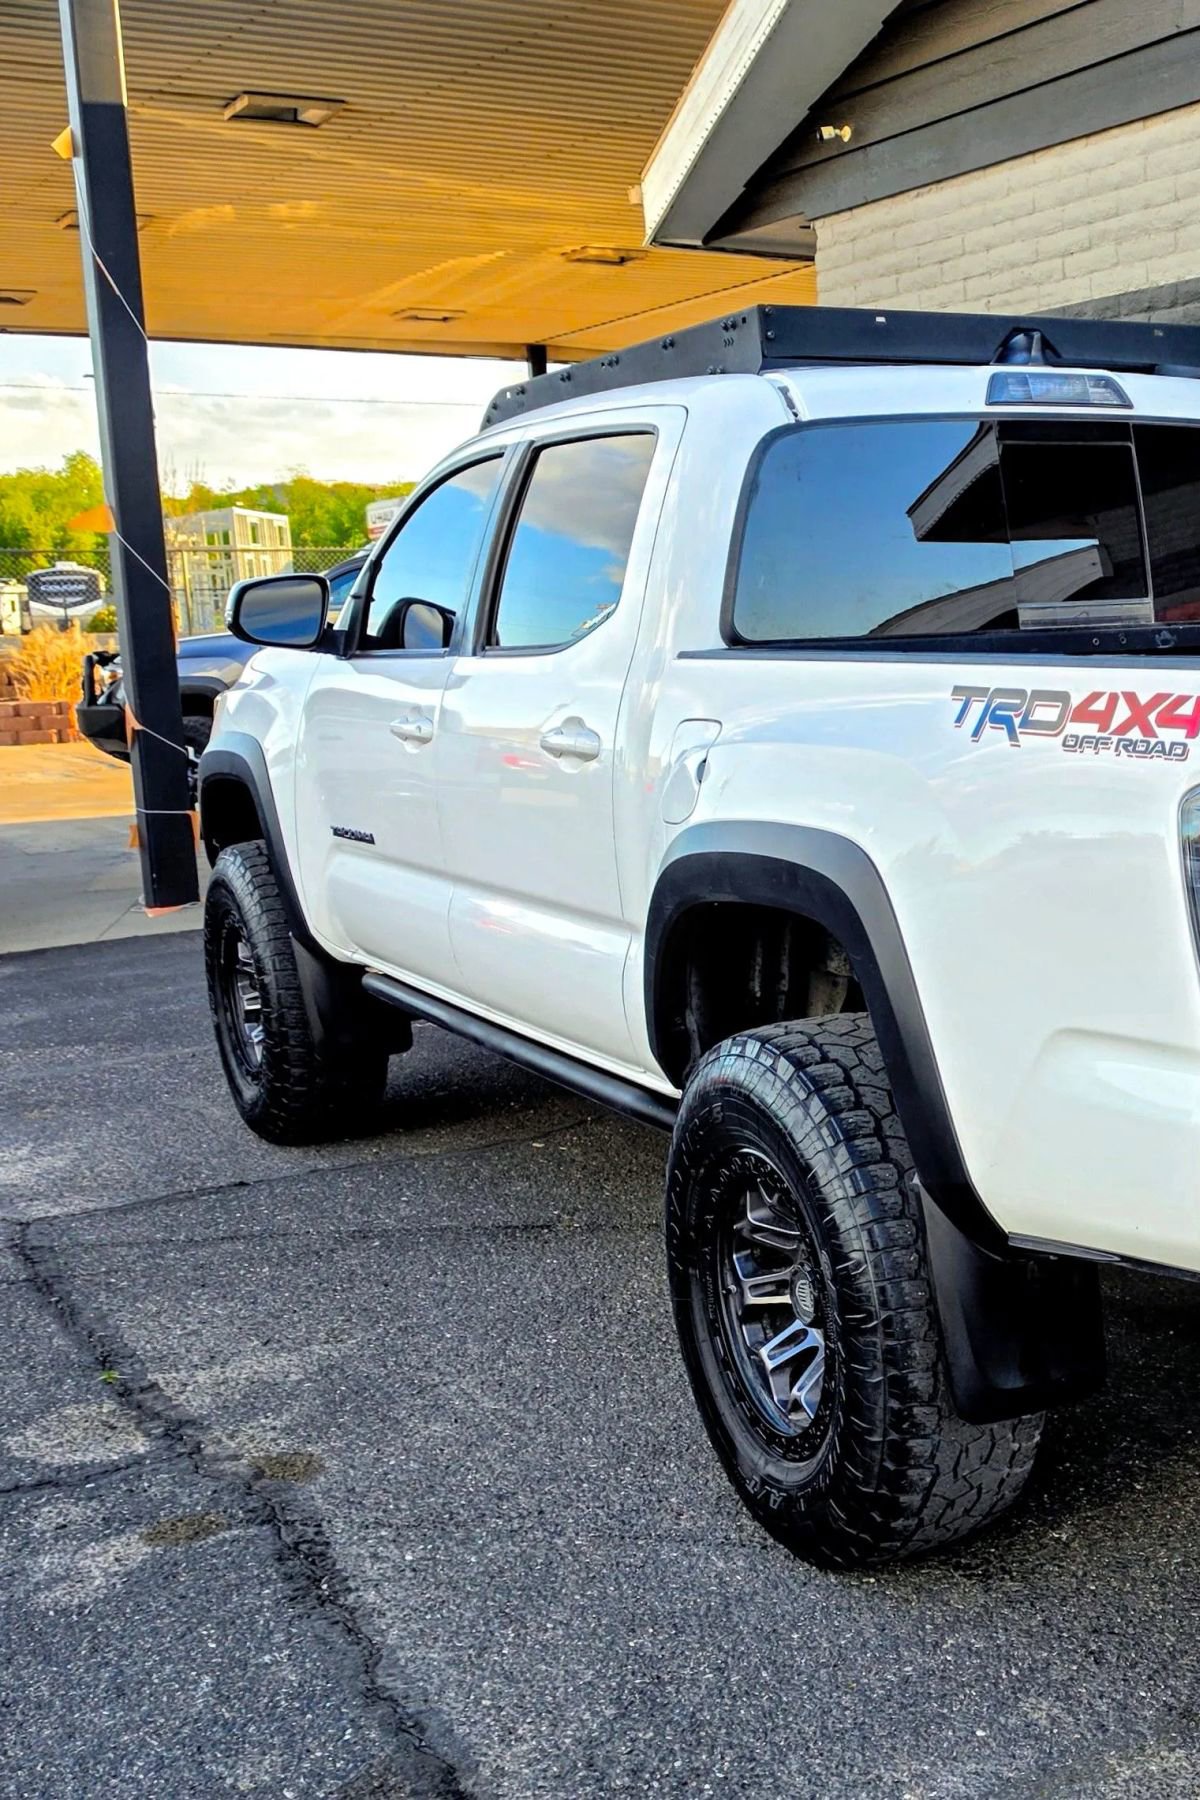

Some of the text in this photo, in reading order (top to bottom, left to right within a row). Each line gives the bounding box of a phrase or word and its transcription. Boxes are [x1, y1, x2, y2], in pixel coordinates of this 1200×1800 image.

[951, 685, 1072, 747] TRD
[1061, 733, 1190, 761] OFF ROAD
